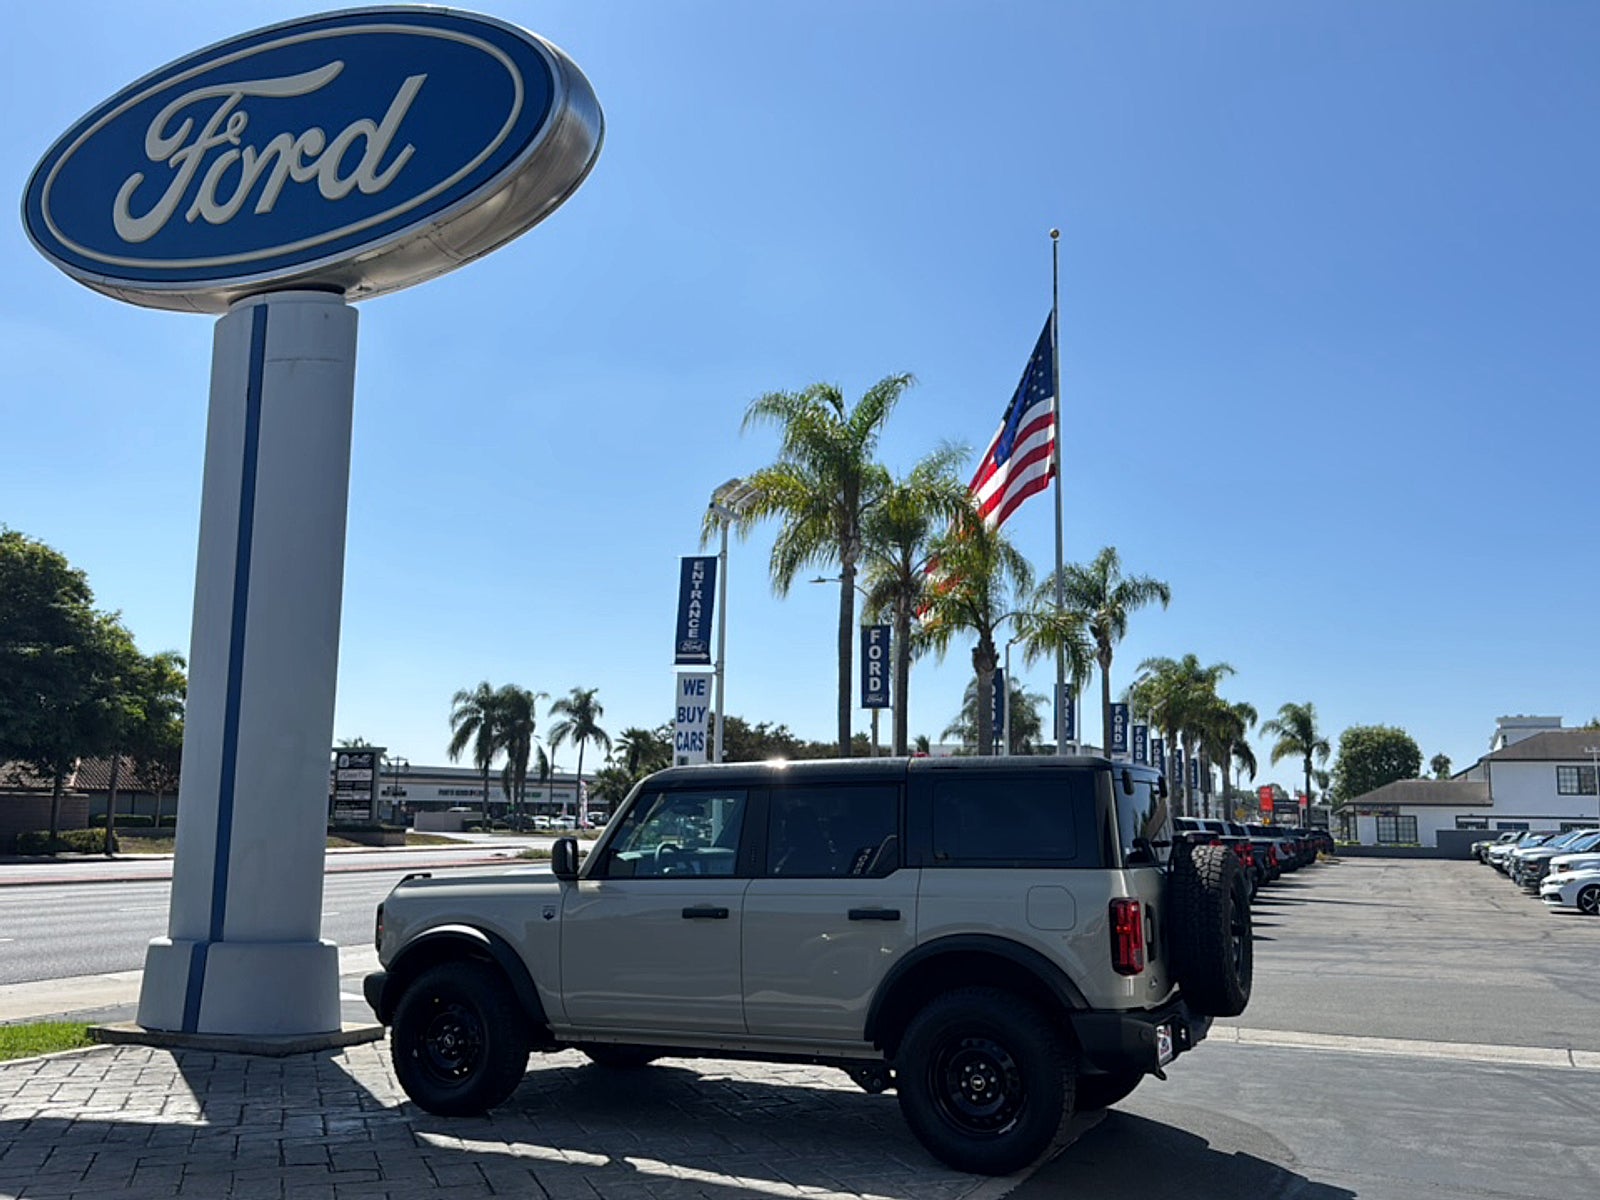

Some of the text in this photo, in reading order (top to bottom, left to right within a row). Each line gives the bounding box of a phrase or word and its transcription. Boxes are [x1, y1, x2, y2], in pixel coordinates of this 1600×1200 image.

[113, 60, 428, 243] Ford
[687, 560, 705, 638] ENTRANCE
[868, 629, 882, 692] FORD
[683, 679, 706, 696] WE
[677, 706, 706, 723] BUY
[1114, 705, 1123, 743] FORD
[676, 731, 704, 752] CARS
[1135, 726, 1143, 760] FORD
